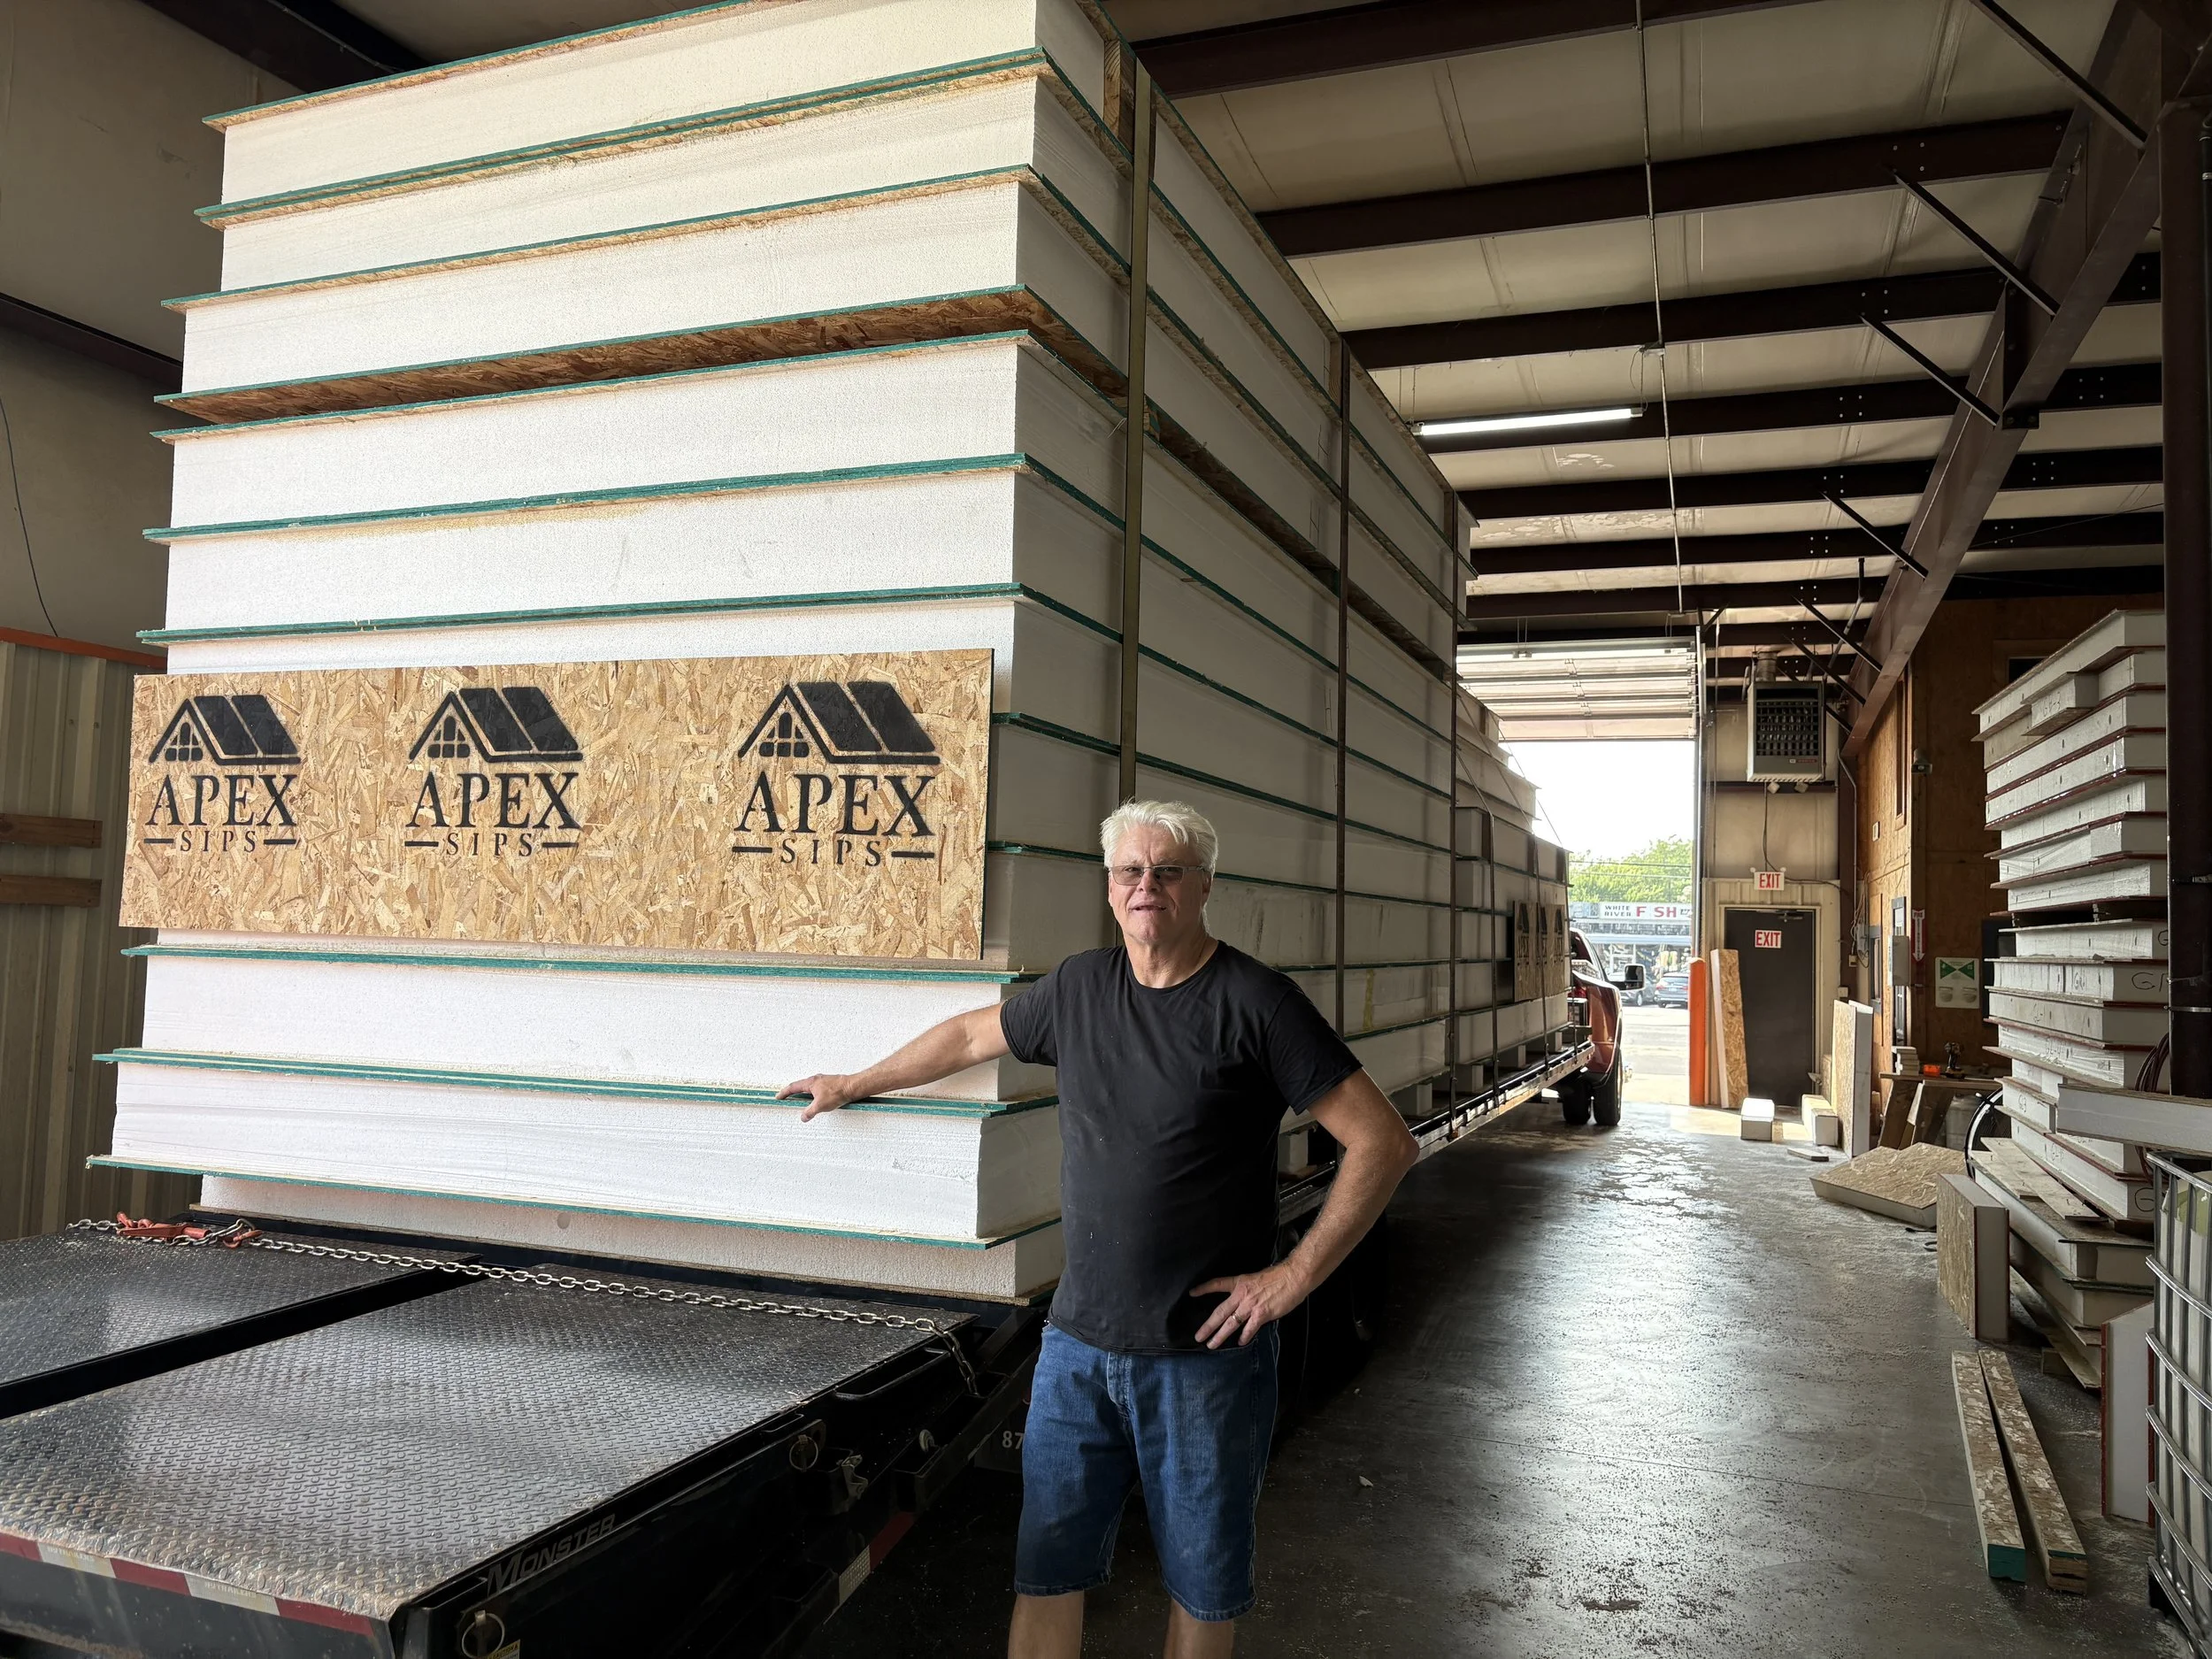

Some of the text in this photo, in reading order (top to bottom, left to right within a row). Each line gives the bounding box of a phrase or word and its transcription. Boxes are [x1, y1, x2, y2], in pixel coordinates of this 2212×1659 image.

[144, 774, 298, 826] APEX
[405, 772, 583, 829] APEX
[733, 771, 936, 837] APEX
[180, 830, 257, 853] SIPS
[446, 832, 533, 856] SIPS
[780, 838, 881, 867] SIPS
[1759, 872, 1781, 889] EXIT
[1636, 906, 1677, 918] FSH
[1755, 931, 1781, 948] EXIT
[487, 1513, 617, 1597] MONSTER
